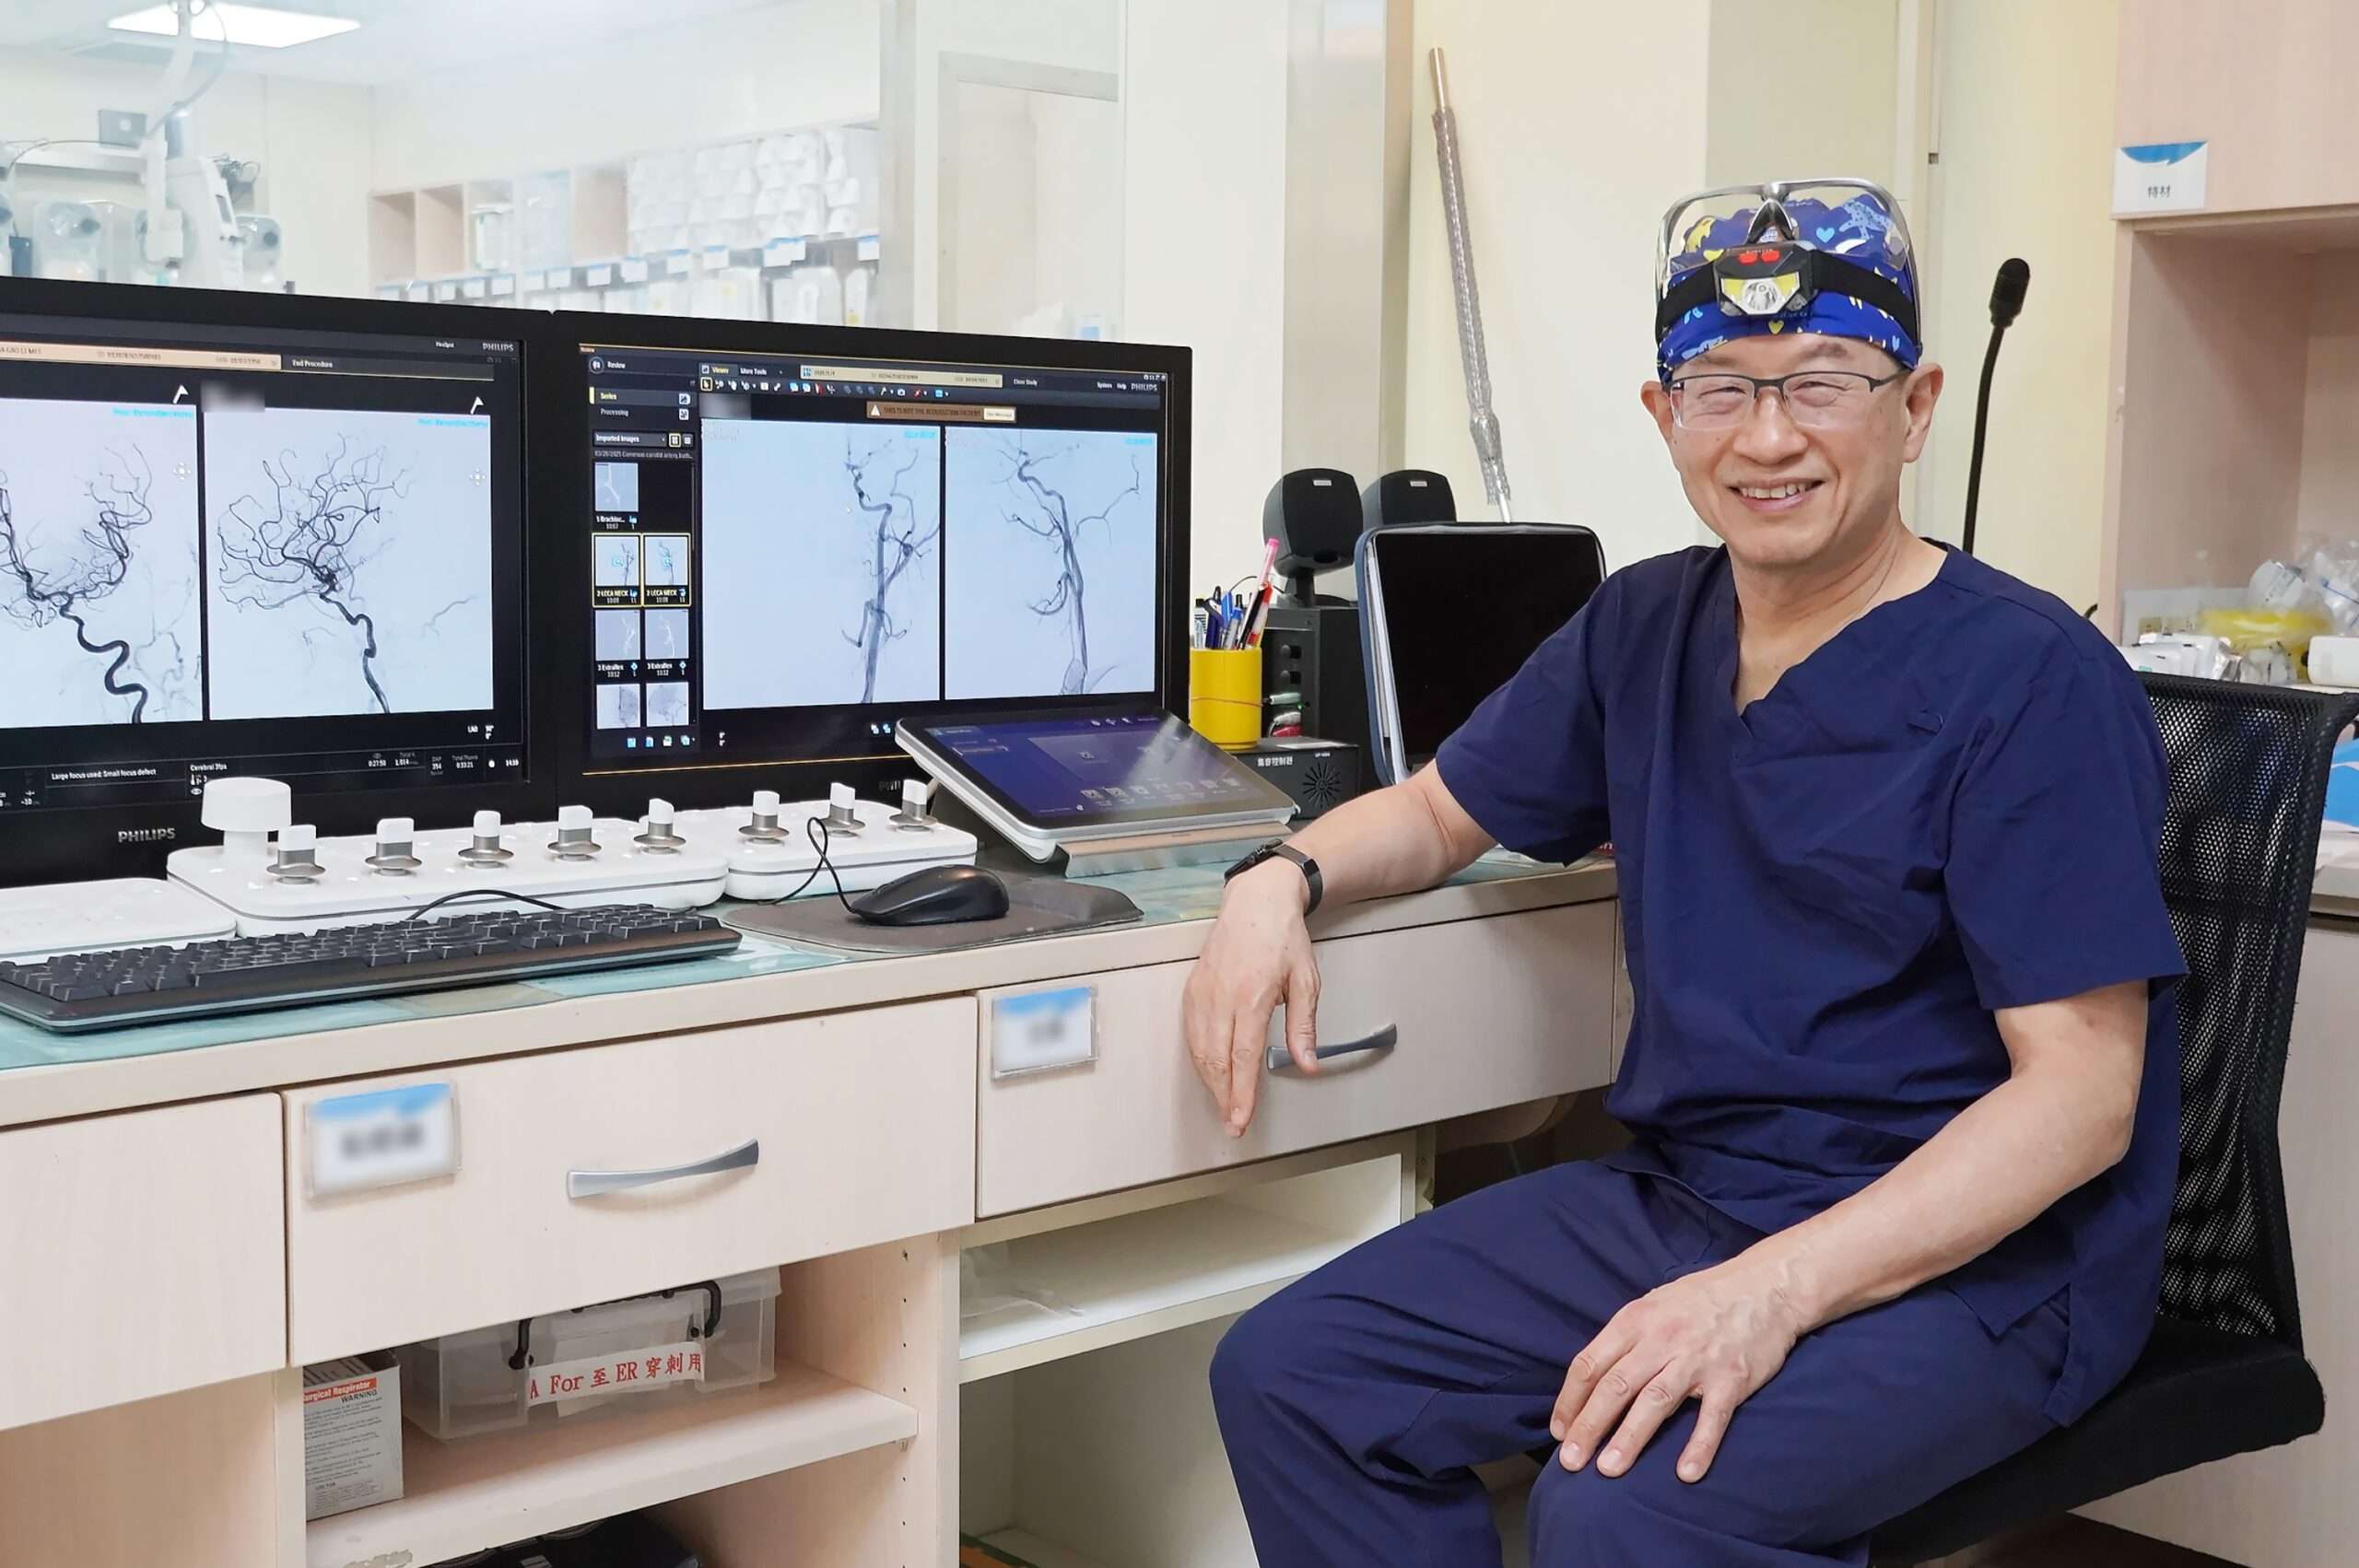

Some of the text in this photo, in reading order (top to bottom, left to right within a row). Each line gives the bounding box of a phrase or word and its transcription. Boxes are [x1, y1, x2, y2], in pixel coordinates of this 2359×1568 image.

[482, 342, 514, 352] PHILIPS
[292, 359, 333, 369] End Procedure
[1131, 382, 1157, 392] PHILIPS
[600, 392, 617, 401] Series
[600, 408, 628, 417] Processing
[595, 434, 640, 444] Imported Images
[190, 764, 215, 772] Cerebral
[52, 772, 69, 780] Large
[69, 771, 86, 779] focus
[103, 769, 120, 778] Small
[120, 768, 136, 777] focus
[137, 767, 157, 776] defect
[118, 827, 176, 844] PHILIPS
[530, 1379, 539, 1399] A
[550, 1374, 584, 1396] For
[591, 1368, 610, 1387] 至
[616, 1362, 639, 1382] ER
[333, 1381, 370, 1395] Respirator
[341, 1389, 378, 1403] WARNING
